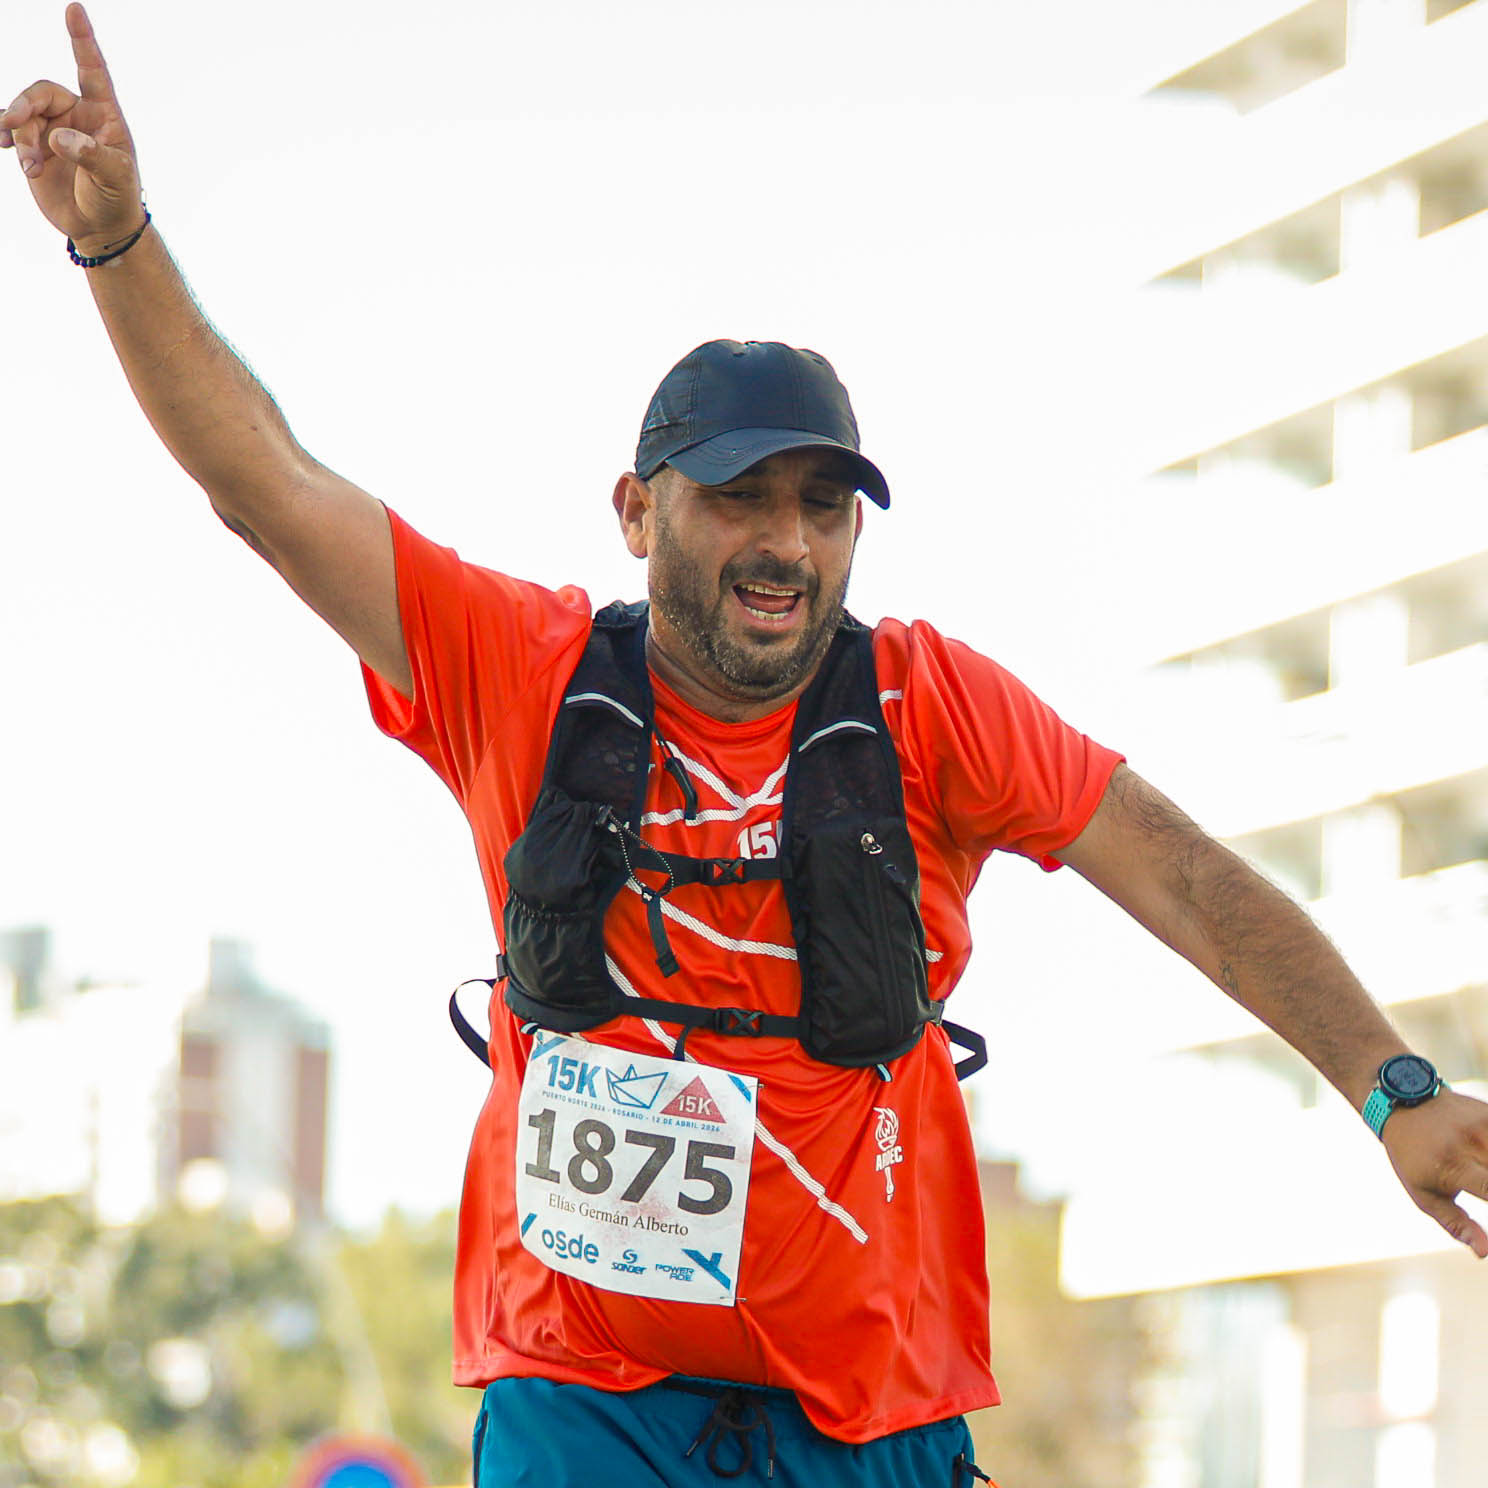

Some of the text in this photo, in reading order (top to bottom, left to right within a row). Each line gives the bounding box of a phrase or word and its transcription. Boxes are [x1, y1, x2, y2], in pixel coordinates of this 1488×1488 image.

[737, 819, 783, 859] 15
[548, 1055, 601, 1098] 15K
[542, 1090, 566, 1102] PUERTO
[612, 1108, 644, 1120] ROSARIO
[663, 1117, 673, 1125] DE
[675, 1120, 699, 1129] ABRIL
[678, 1095, 712, 1115] 15K
[525, 1108, 736, 1215] 1875
[548, 1193, 689, 1236] Elías Germán Alberto
[542, 1228, 600, 1264] osde
